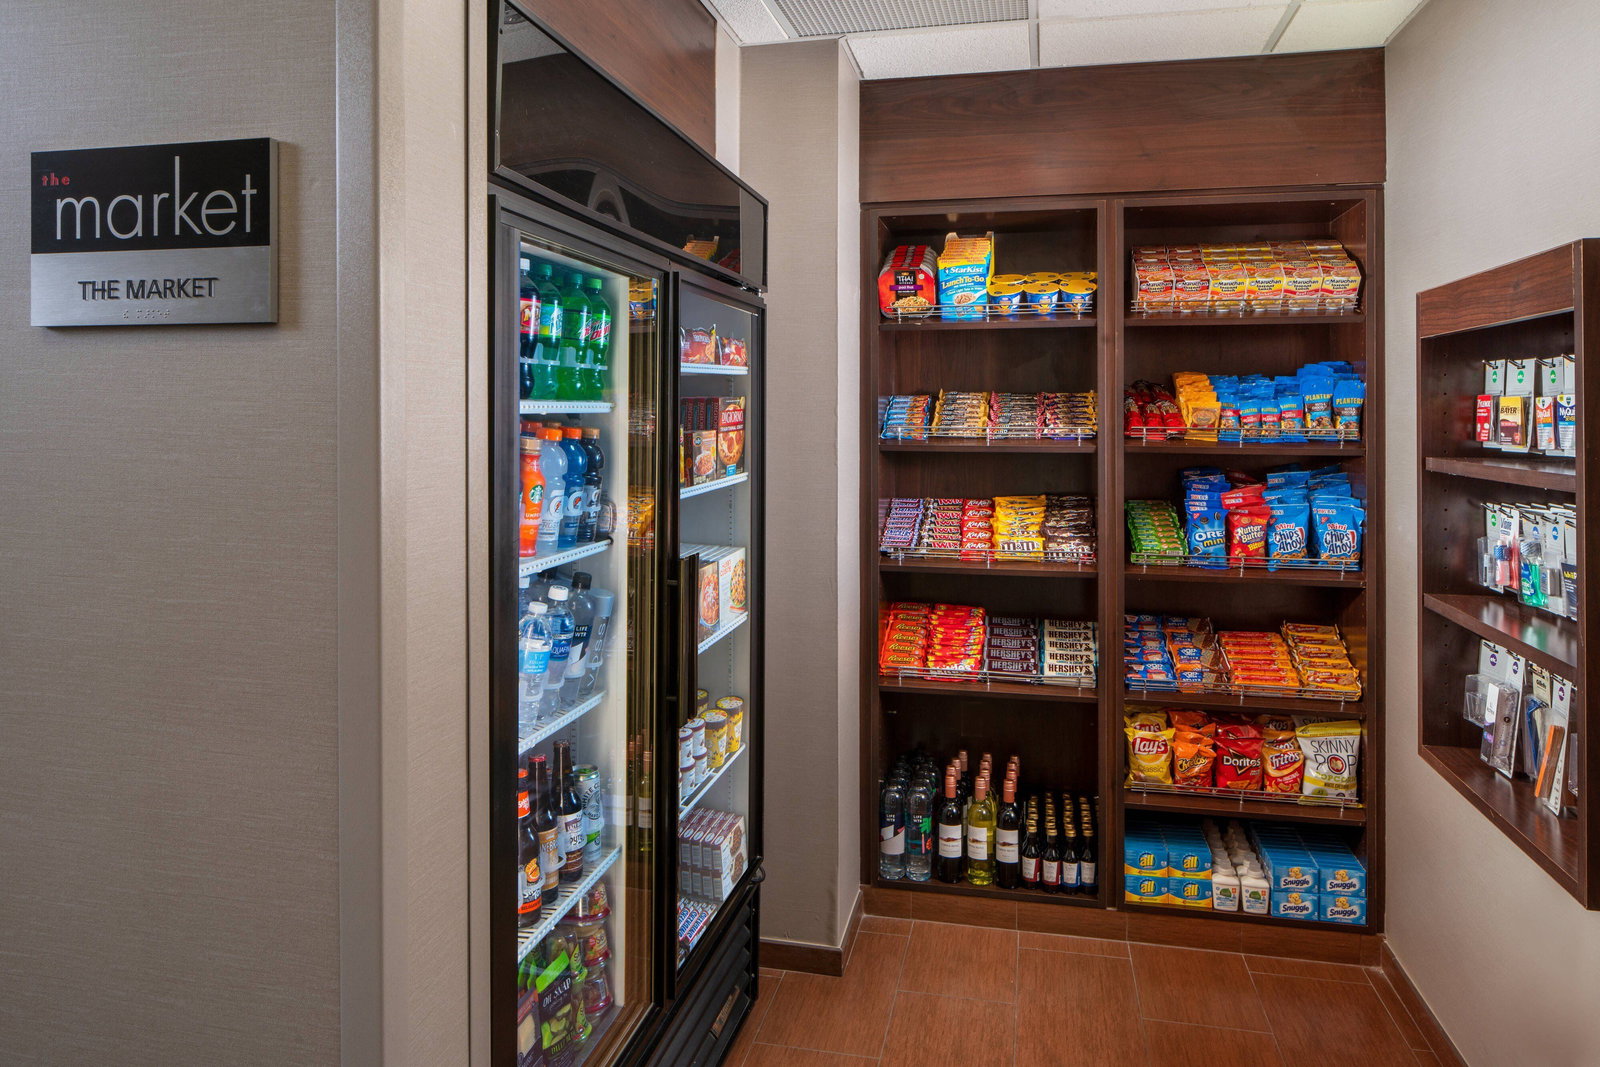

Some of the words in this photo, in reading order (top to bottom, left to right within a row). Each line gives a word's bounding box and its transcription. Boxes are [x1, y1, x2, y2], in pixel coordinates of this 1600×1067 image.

[42, 172, 70, 186] the
[56, 156, 257, 240] market
[78, 281, 119, 300] THE
[126, 278, 218, 299] MARKET
[1500, 407, 1518, 415] BAYER
[1195, 530, 1226, 540] ORE
[1237, 525, 1263, 537] Nutter
[1242, 531, 1264, 543] Butter
[1273, 530, 1300, 543] Chips
[1324, 531, 1351, 546] Chips
[1048, 631, 1089, 639] HERSHEY'S
[991, 639, 1033, 647] HERSHEY'S
[1049, 641, 1090, 649] HERSHEY'S
[990, 649, 1033, 658] HERSHEY'S
[1049, 653, 1091, 661] HERSHEY'S
[991, 661, 1035, 670] HERSHEY'S
[1048, 664, 1090, 673] HERSHEY'S
[1134, 737, 1167, 754] Lay's
[1310, 738, 1355, 753] SKINNY
[1223, 756, 1261, 767] Doritos
[1269, 752, 1300, 769] Fritos
[1314, 754, 1357, 776] POP
[1140, 854, 1155, 867] all
[1183, 856, 1199, 869] all
[1141, 881, 1155, 894] all
[1282, 879, 1310, 887] Snuggle
[1329, 881, 1357, 890] Snuggle
[1184, 884, 1199, 897] all
[1282, 905, 1310, 913] Snuggle
[1329, 909, 1357, 917] Snuggle
